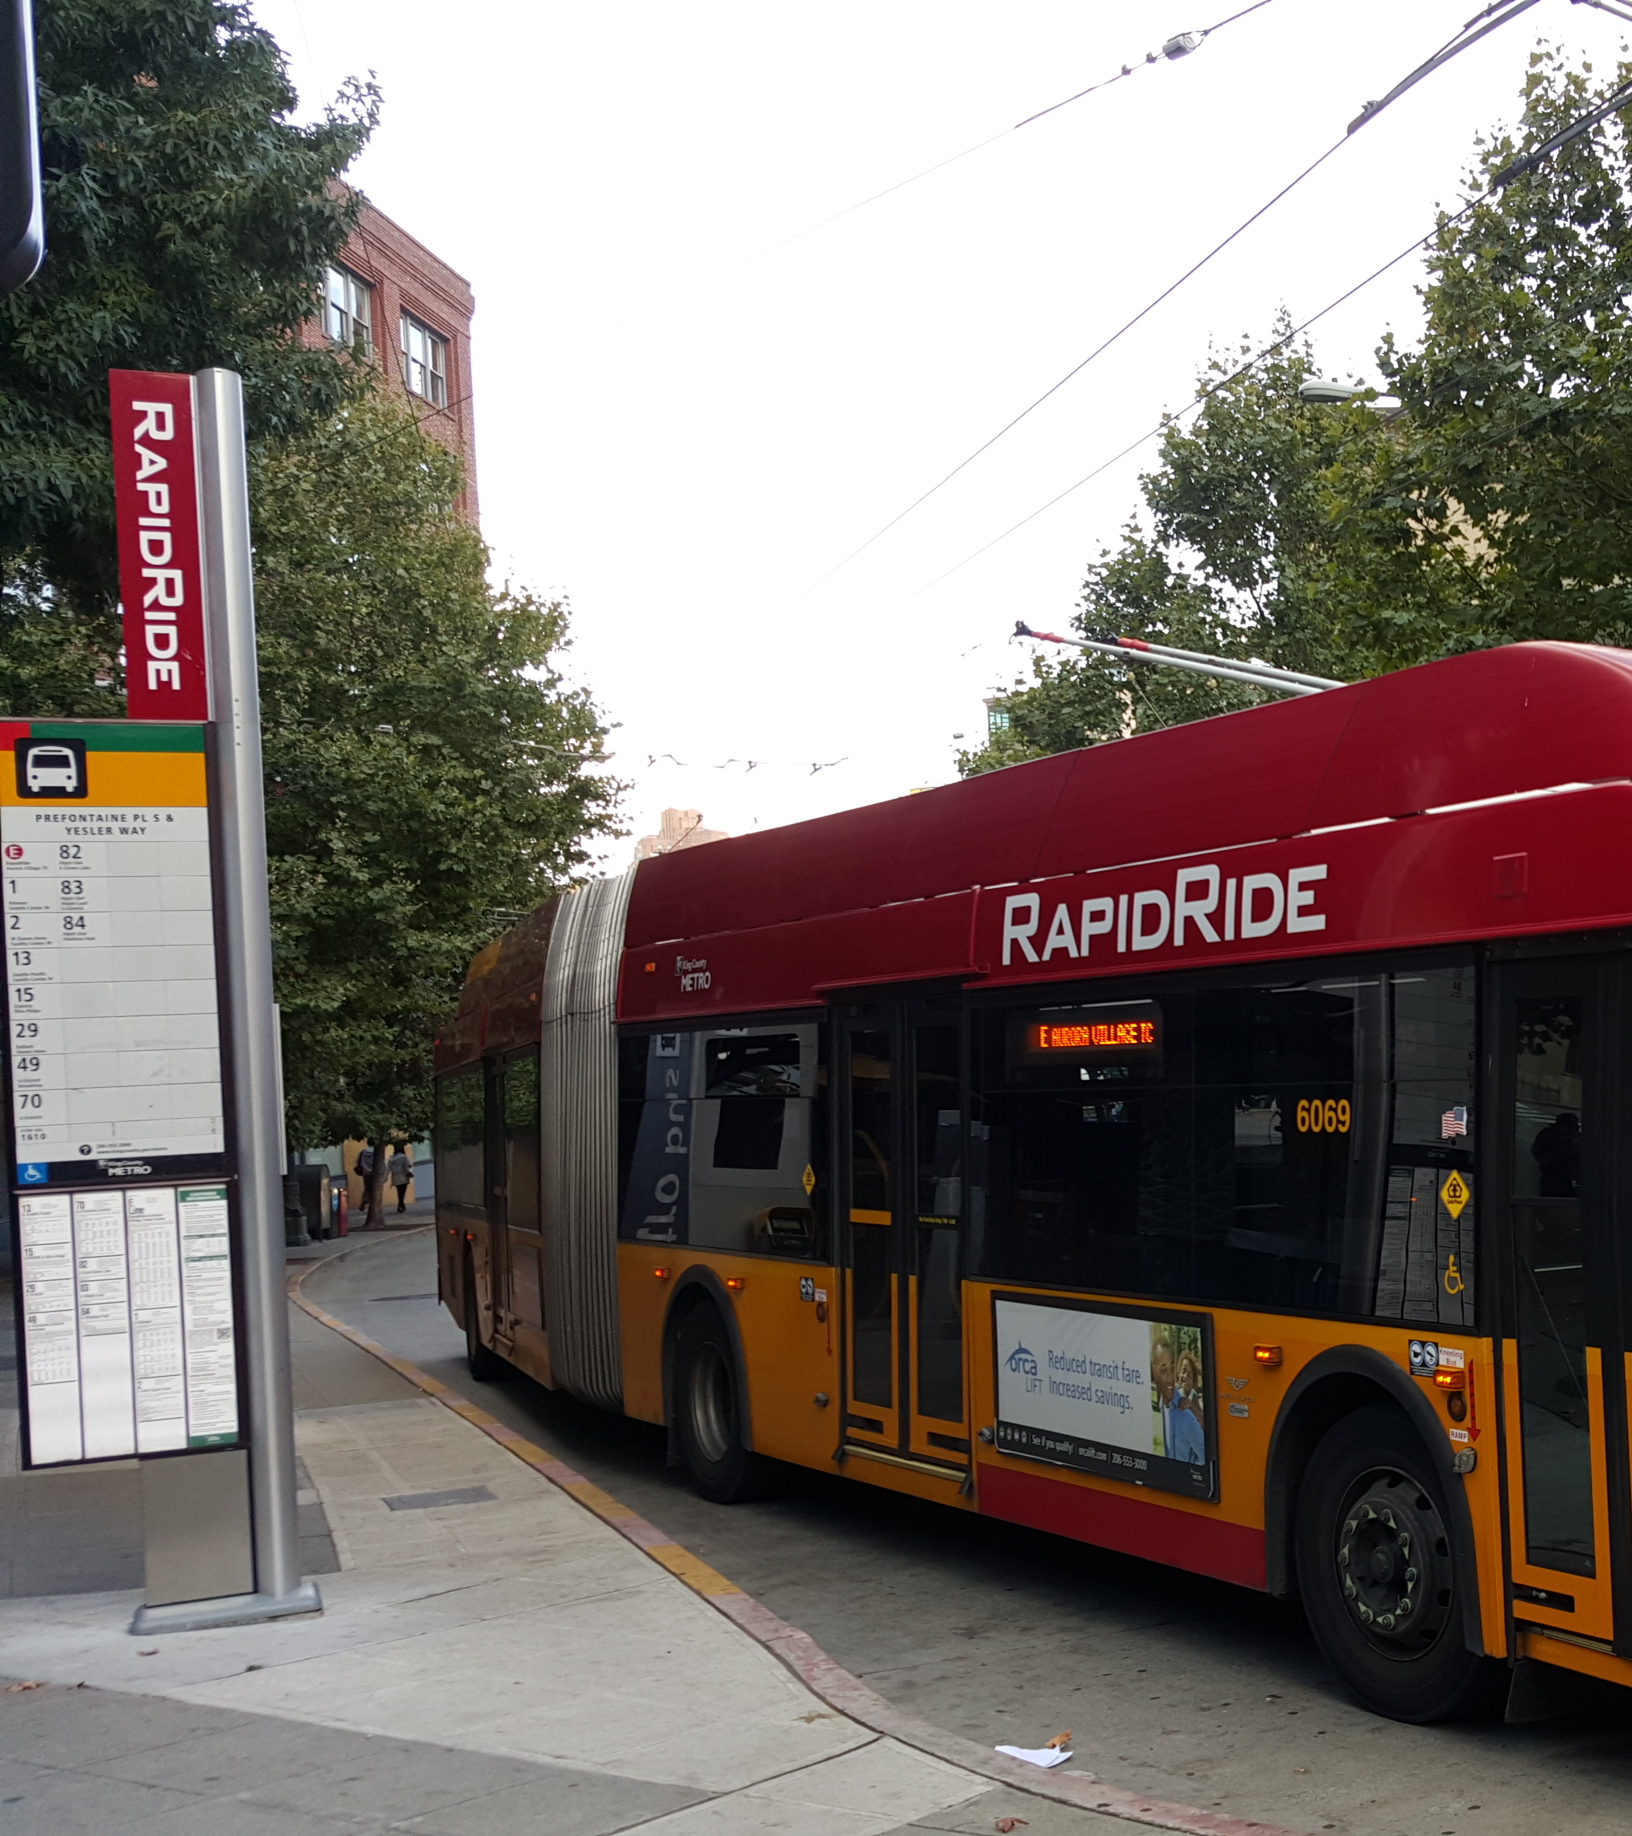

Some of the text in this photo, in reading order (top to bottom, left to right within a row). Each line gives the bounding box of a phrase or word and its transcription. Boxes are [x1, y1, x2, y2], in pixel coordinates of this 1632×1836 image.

[132, 401, 184, 690] RAPIDRIDE
[35, 814, 175, 823] PREFONTAINE PL S &
[65, 827, 147, 836] YESLER WAY
[9, 846, 22, 858] E
[59, 845, 82, 859] 82
[9, 880, 17, 894] 1
[61, 880, 84, 894] 83
[1002, 863, 1328, 966] RAPIDRIDE
[10, 915, 20, 930] 2
[63, 916, 86, 930] 84
[12, 951, 31, 966] 13
[681, 971, 711, 992] METRO
[15, 987, 34, 1002] 15
[16, 1023, 38, 1038] 29
[1040, 1026, 1049, 1048] E
[1091, 1023, 1138, 1046] VILLAGE
[1140, 1022, 1154, 1043] TC
[17, 1057, 40, 1071] 49
[19, 1093, 42, 1109] 70
[1296, 1099, 1351, 1133] 6069
[108, 1165, 152, 1176] METRO
[1439, 1348, 1463, 1360] Kneeling
[1009, 1354, 1038, 1376] orca
[1048, 1349, 1144, 1385] Reduced transit fare.
[1446, 1357, 1457, 1367] Bus
[1025, 1376, 1044, 1394] LIFT
[1049, 1376, 1133, 1415] Increased savings.
[1451, 1430, 1467, 1440] RAMP
